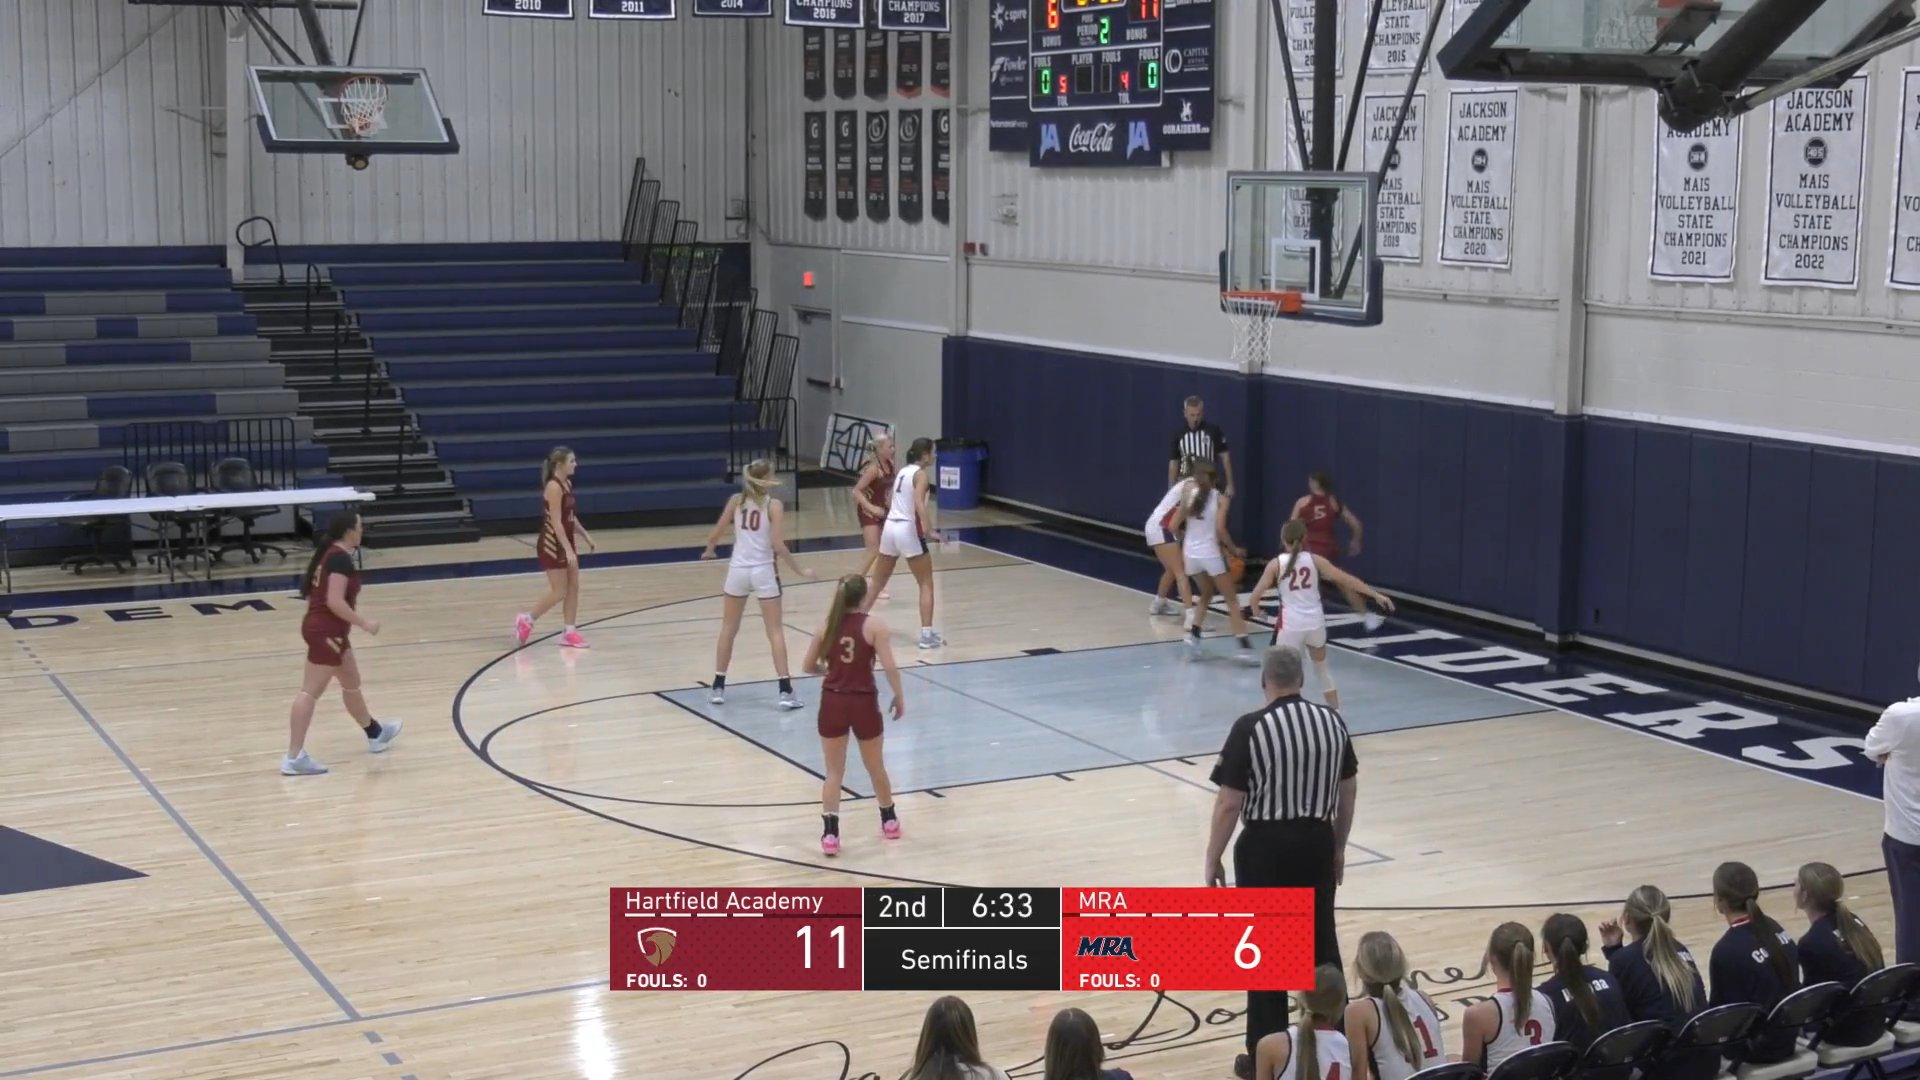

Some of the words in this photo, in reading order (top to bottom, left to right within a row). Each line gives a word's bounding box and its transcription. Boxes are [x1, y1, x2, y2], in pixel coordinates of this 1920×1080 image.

[515, 0, 541, 10] 2010
[621, 1, 644, 13] 2011
[720, 0, 744, 8] 2014
[796, 0, 853, 8] CHAMPIONS
[888, 1, 941, 12] CHAMPIONS
[903, 13, 926, 23] 2017
[1290, 6, 1315, 18] VOLLE
[1384, 16, 1410, 28] STATE
[1077, 24, 1098, 36] PERIOD
[1099, 17, 1110, 44] 2
[1126, 28, 1147, 40] BONUS
[1374, 33, 1421, 46] CHAMPIONS
[1071, 53, 1093, 65] PLAYER
[1102, 51, 1121, 62] FOULS
[1139, 48, 1159, 60] FOULS
[1184, 47, 1208, 57] CAPITAL
[1387, 50, 1406, 62] 2015
[1041, 69, 1051, 94] 0
[1147, 62, 1158, 89] 0
[1787, 90, 1853, 110] JACKSON
[1373, 106, 1417, 122] JACKON
[1460, 102, 1507, 118] JACKSON
[1785, 112, 1854, 133] ACADEMY
[1457, 125, 1507, 141] ACADEMY
[1382, 177, 1402, 190] MAIS
[1467, 180, 1490, 193] MAIS
[1683, 177, 1710, 192] MAIS
[1799, 174, 1830, 190] MAIS
[1377, 192, 1421, 205] LLEYBALL
[1450, 195, 1508, 211] VOLLEYBALL
[1659, 195, 1735, 211] VOLLEYBALL
[1776, 193, 1856, 211] VOLLEYBALL
[1380, 207, 1405, 219] STATE
[1464, 211, 1491, 225] STATE
[1376, 221, 1417, 234] HAMPIONS
[1678, 214, 1714, 229] STATE
[1794, 214, 1832, 230] STATE
[1383, 235, 1400, 247] 2019
[1453, 226, 1504, 241] CHAMPIONS
[1663, 233, 1728, 248] CHAMPIONS
[1464, 242, 1487, 255] 2020
[1779, 234, 1848, 251] CHAMPIONS
[1681, 251, 1707, 266] 2021
[1795, 254, 1825, 270] 2022
[895, 474, 906, 493] 1
[740, 508, 761, 532] 10
[1313, 505, 1327, 520] 5
[1288, 566, 1313, 591] 22
[839, 636, 856, 664] 3
